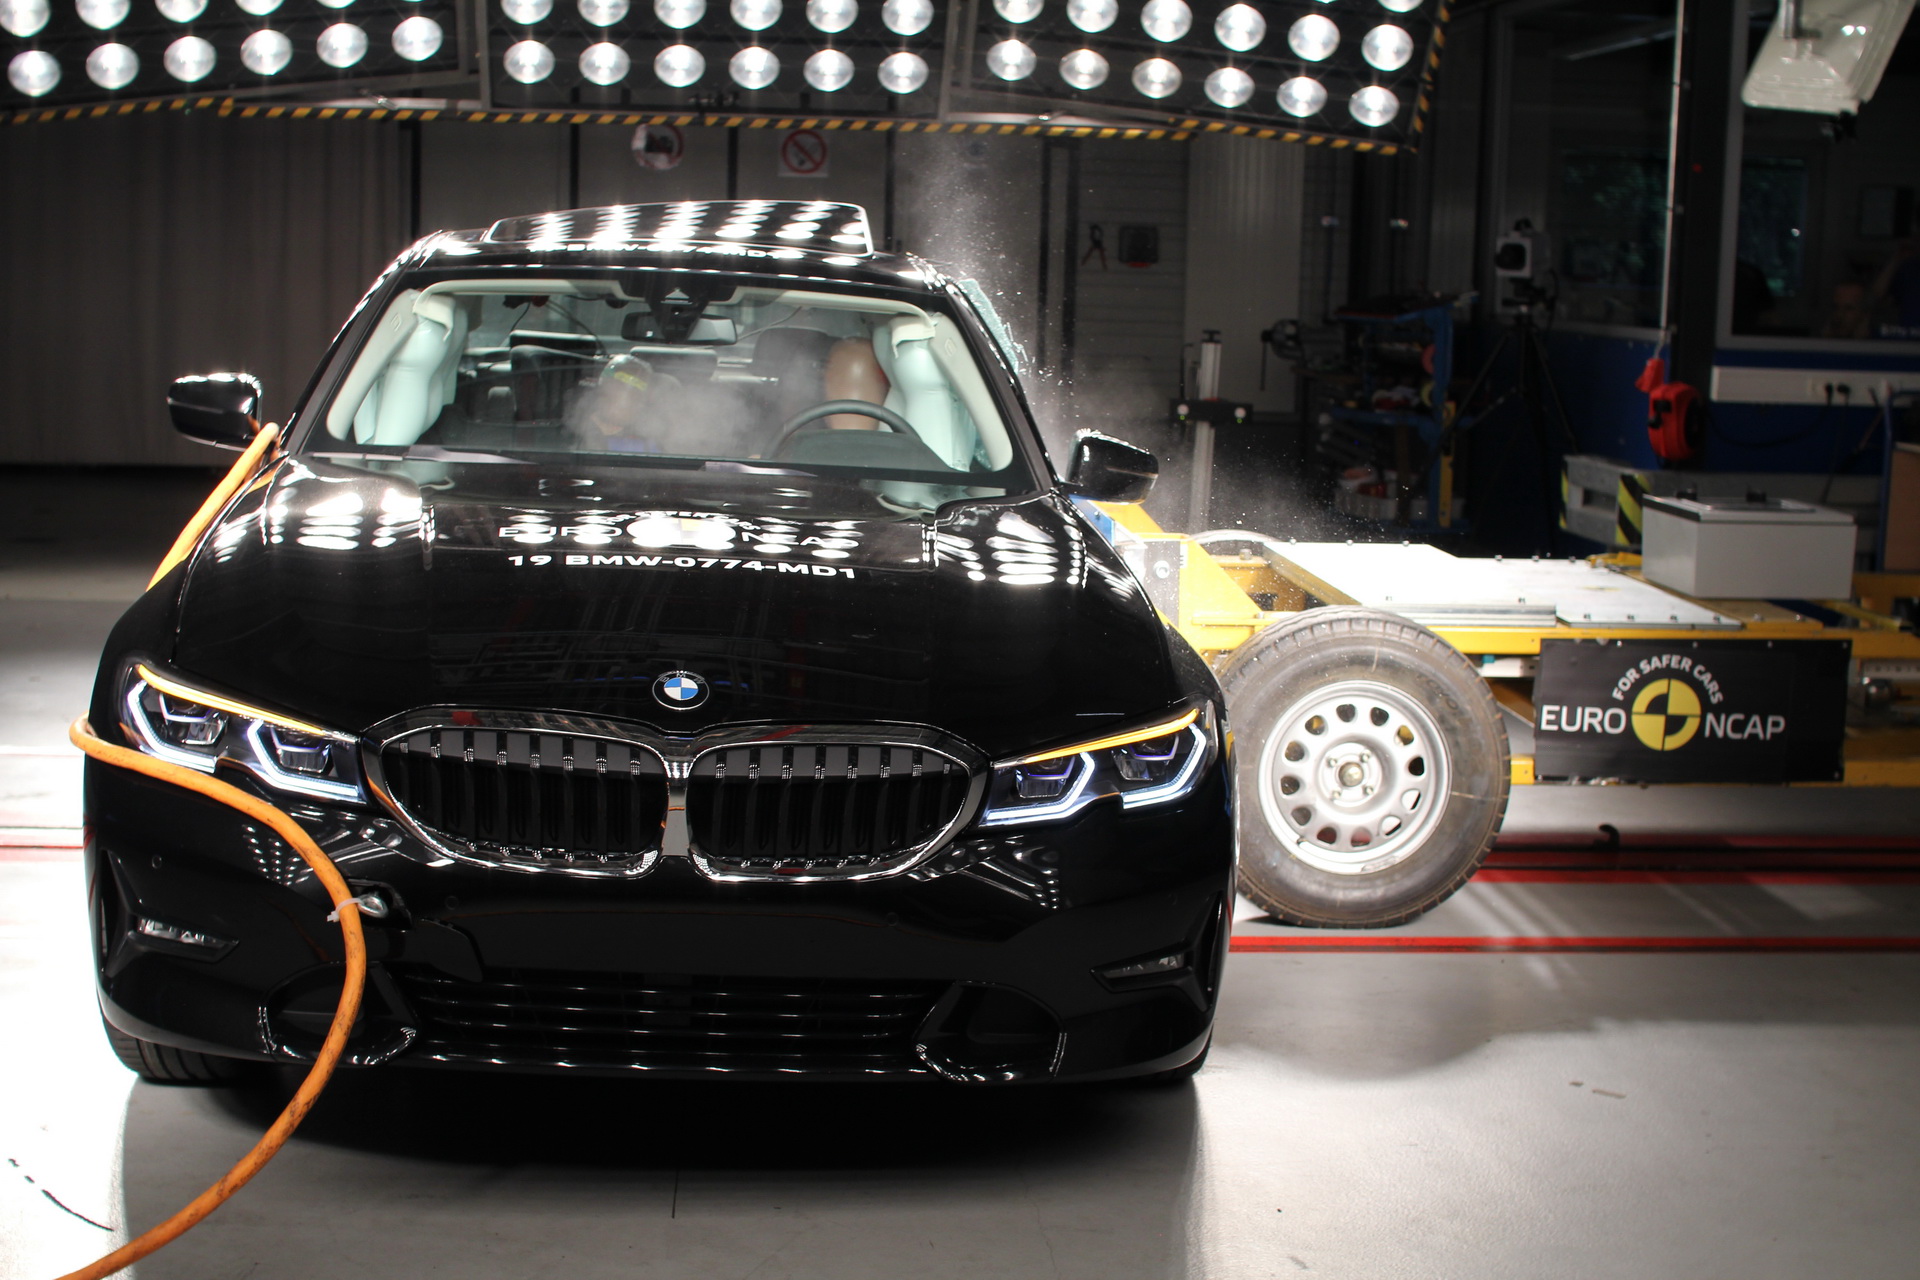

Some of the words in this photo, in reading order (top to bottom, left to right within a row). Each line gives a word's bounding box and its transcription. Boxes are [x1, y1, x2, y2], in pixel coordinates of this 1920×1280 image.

[499, 526, 623, 537] EURO
[508, 555, 552, 566] 19
[565, 555, 855, 579] BMW-0774-MD1
[1612, 668, 1641, 701] FOR
[1639, 654, 1693, 675] SAFER
[1693, 664, 1724, 704] CARS
[1540, 705, 1627, 734] EURO
[1704, 712, 1786, 741] NCAP
